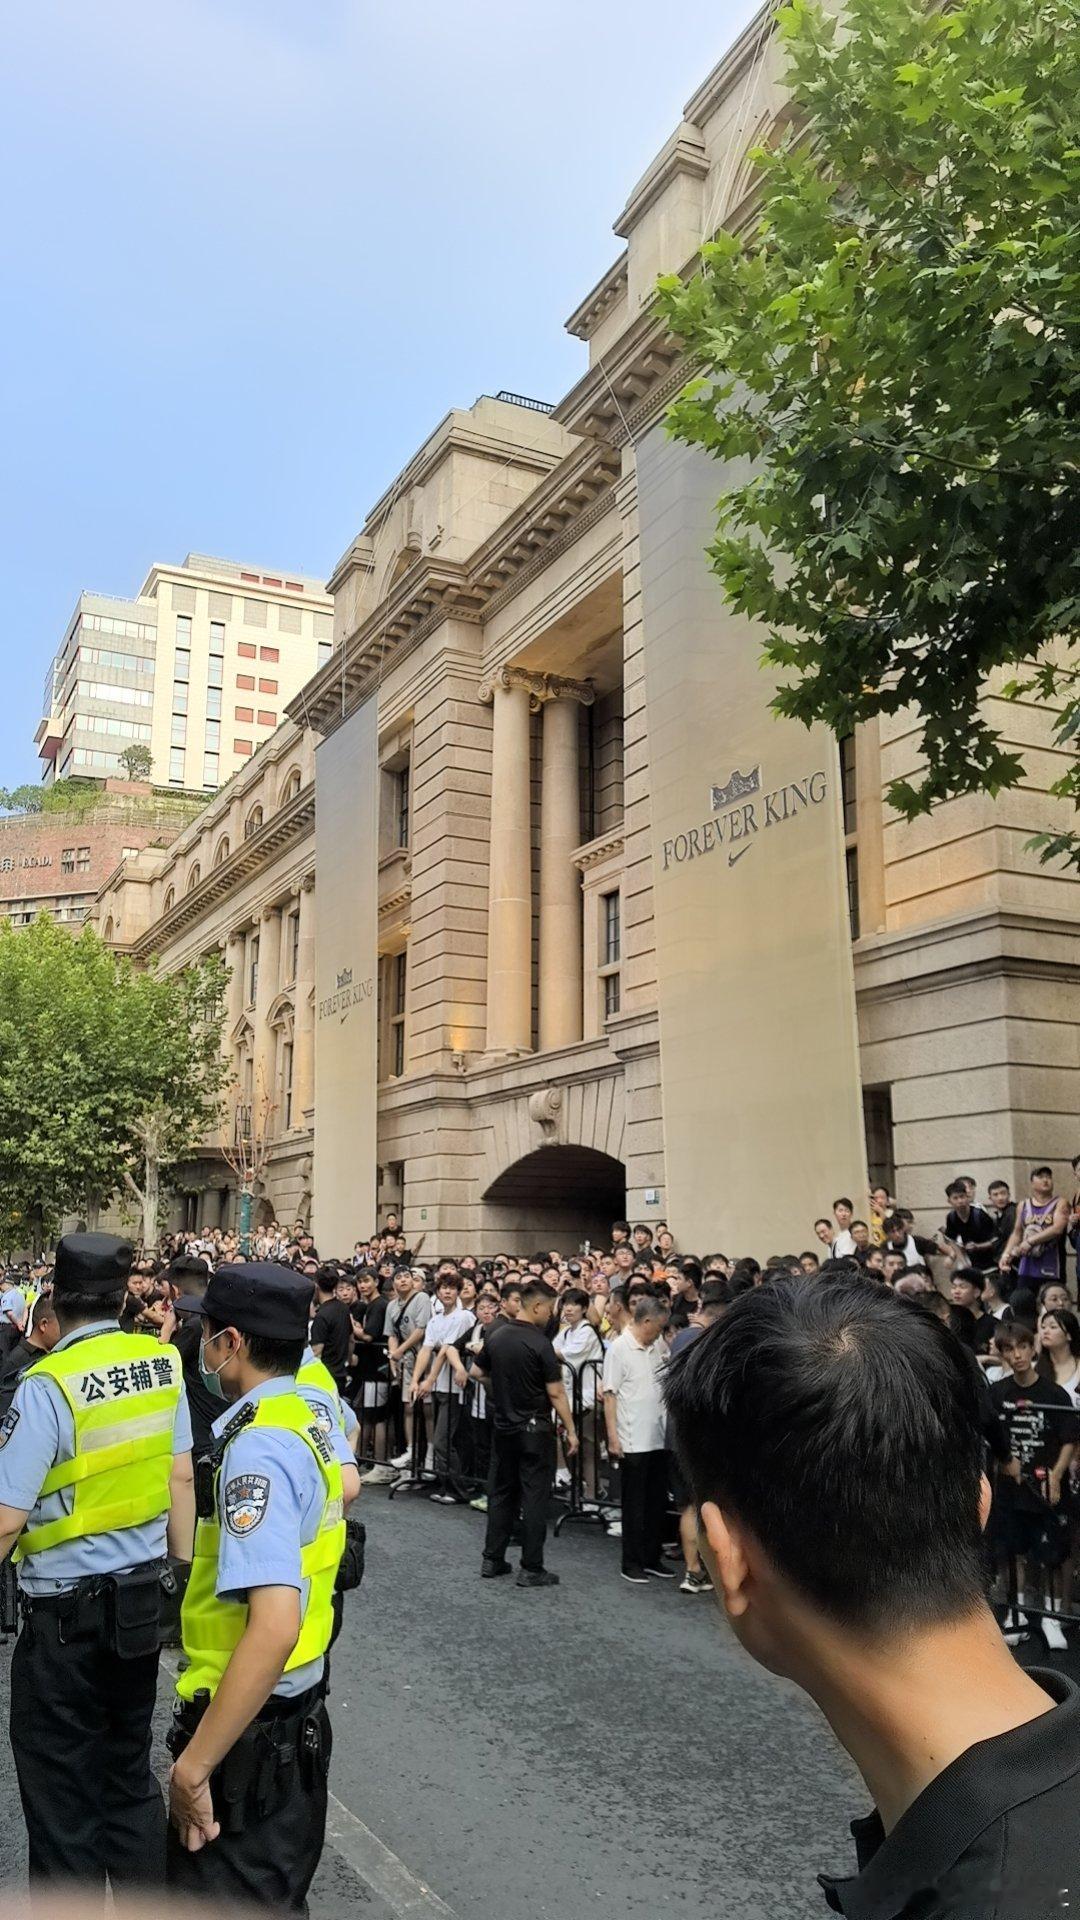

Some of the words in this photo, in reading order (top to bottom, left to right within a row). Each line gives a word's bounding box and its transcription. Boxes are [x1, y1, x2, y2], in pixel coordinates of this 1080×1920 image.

[662, 803, 759, 871] FOREVER
[763, 771, 828, 827] KING
[319, 989, 351, 1020] FOREVER
[352, 977, 373, 1005] KING
[80, 1357, 173, 1402] 公安辅警
